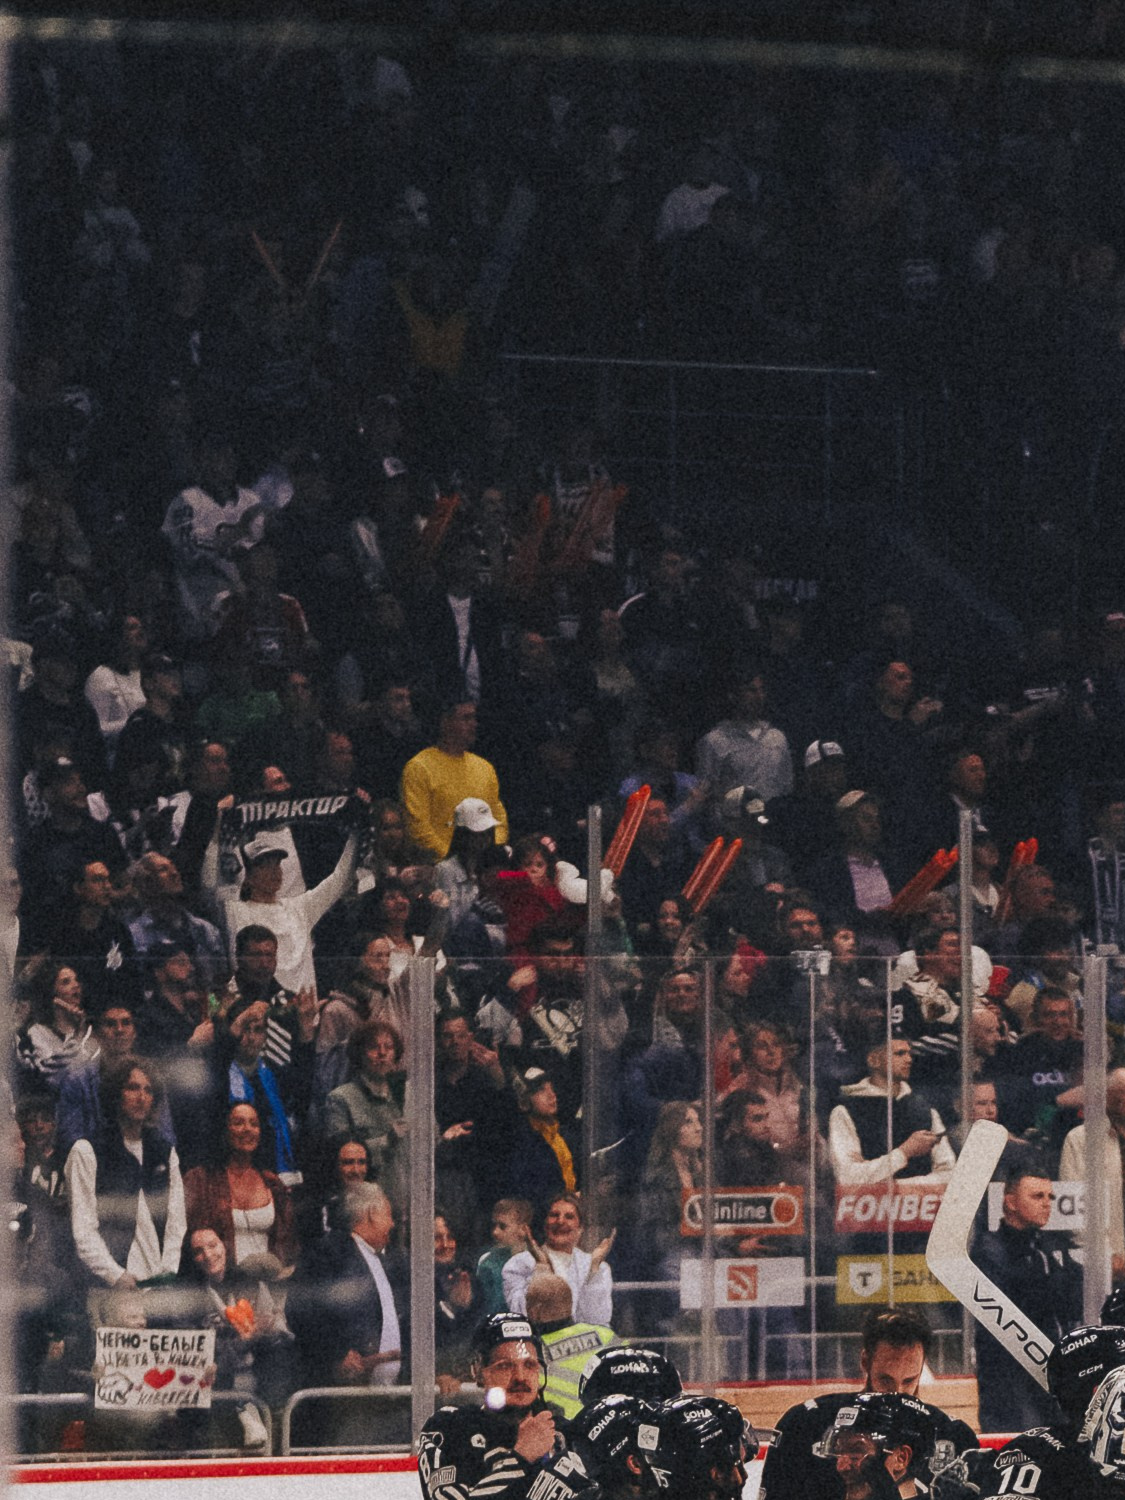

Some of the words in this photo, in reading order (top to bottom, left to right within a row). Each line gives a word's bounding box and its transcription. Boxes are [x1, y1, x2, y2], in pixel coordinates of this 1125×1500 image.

[237, 796, 349, 823] ТРАКТОР
[837, 1194, 942, 1222] FONBE
[973, 1281, 1049, 1374] VAPO
[1060, 1334, 1098, 1355] КОНАР
[997, 1465, 1042, 1495] 10
